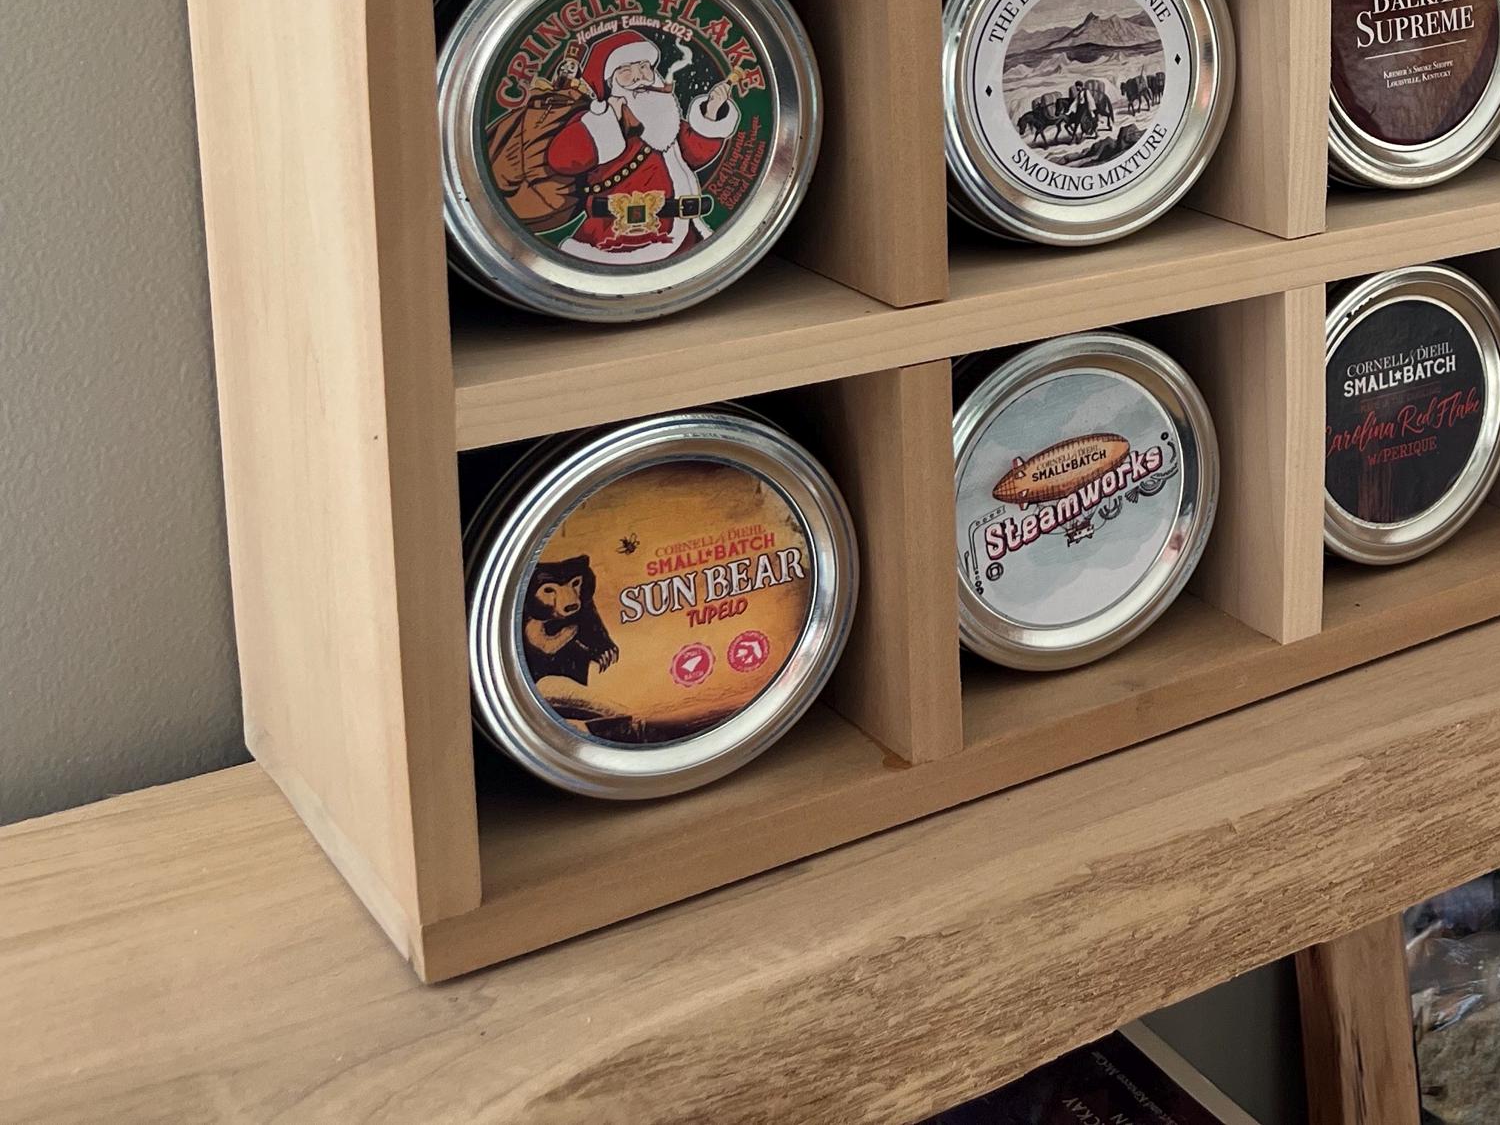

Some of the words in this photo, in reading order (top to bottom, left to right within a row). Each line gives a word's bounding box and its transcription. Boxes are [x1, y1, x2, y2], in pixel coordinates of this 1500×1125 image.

[576, 19, 619, 44] Holiday
[621, 15, 661, 29] Edition
[662, 19, 694, 42] 2023
[989, 2, 1020, 45] THE
[1356, 5, 1475, 49] SUPREME
[1011, 147, 1094, 191] SMOKING
[1097, 124, 1168, 189] MIXTURE
[1343, 369, 1398, 398] SMALL
[1403, 354, 1457, 385] BATCH
[1346, 355, 1408, 378] CORNELL
[1416, 341, 1454, 363] DIEHL
[1397, 397, 1438, 437] Red
[1031, 461, 1068, 482] SMALL
[1071, 449, 1107, 471] BATCH
[984, 444, 1164, 561] Steamworks
[646, 550, 708, 577] SMALL
[714, 531, 775, 562] BATCH
[619, 570, 698, 625] SUN
[702, 546, 805, 605] BEAR
[685, 596, 748, 628] TUPELO
[1061, 1096, 1106, 1125] CKAY
